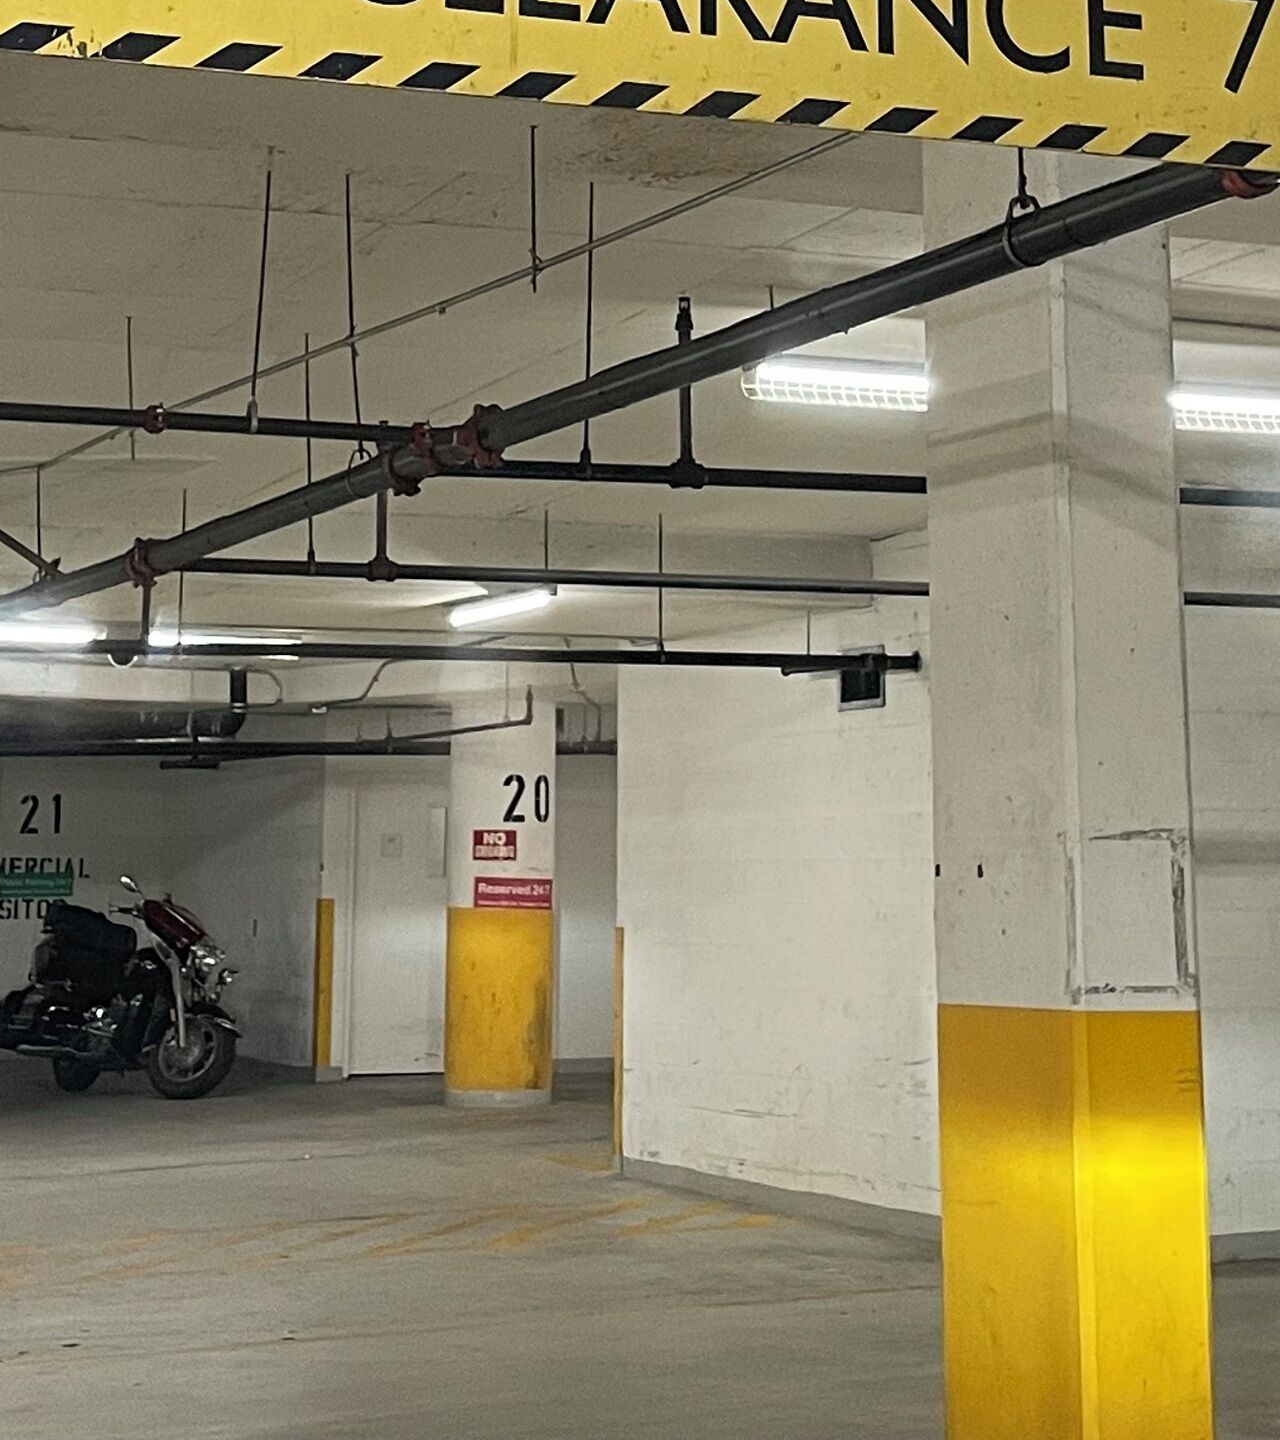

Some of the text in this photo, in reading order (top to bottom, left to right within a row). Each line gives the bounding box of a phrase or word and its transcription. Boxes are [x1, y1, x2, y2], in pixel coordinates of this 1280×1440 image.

[19, 793, 62, 835] 21
[502, 773, 550, 823] 20
[482, 831, 507, 845] NO
